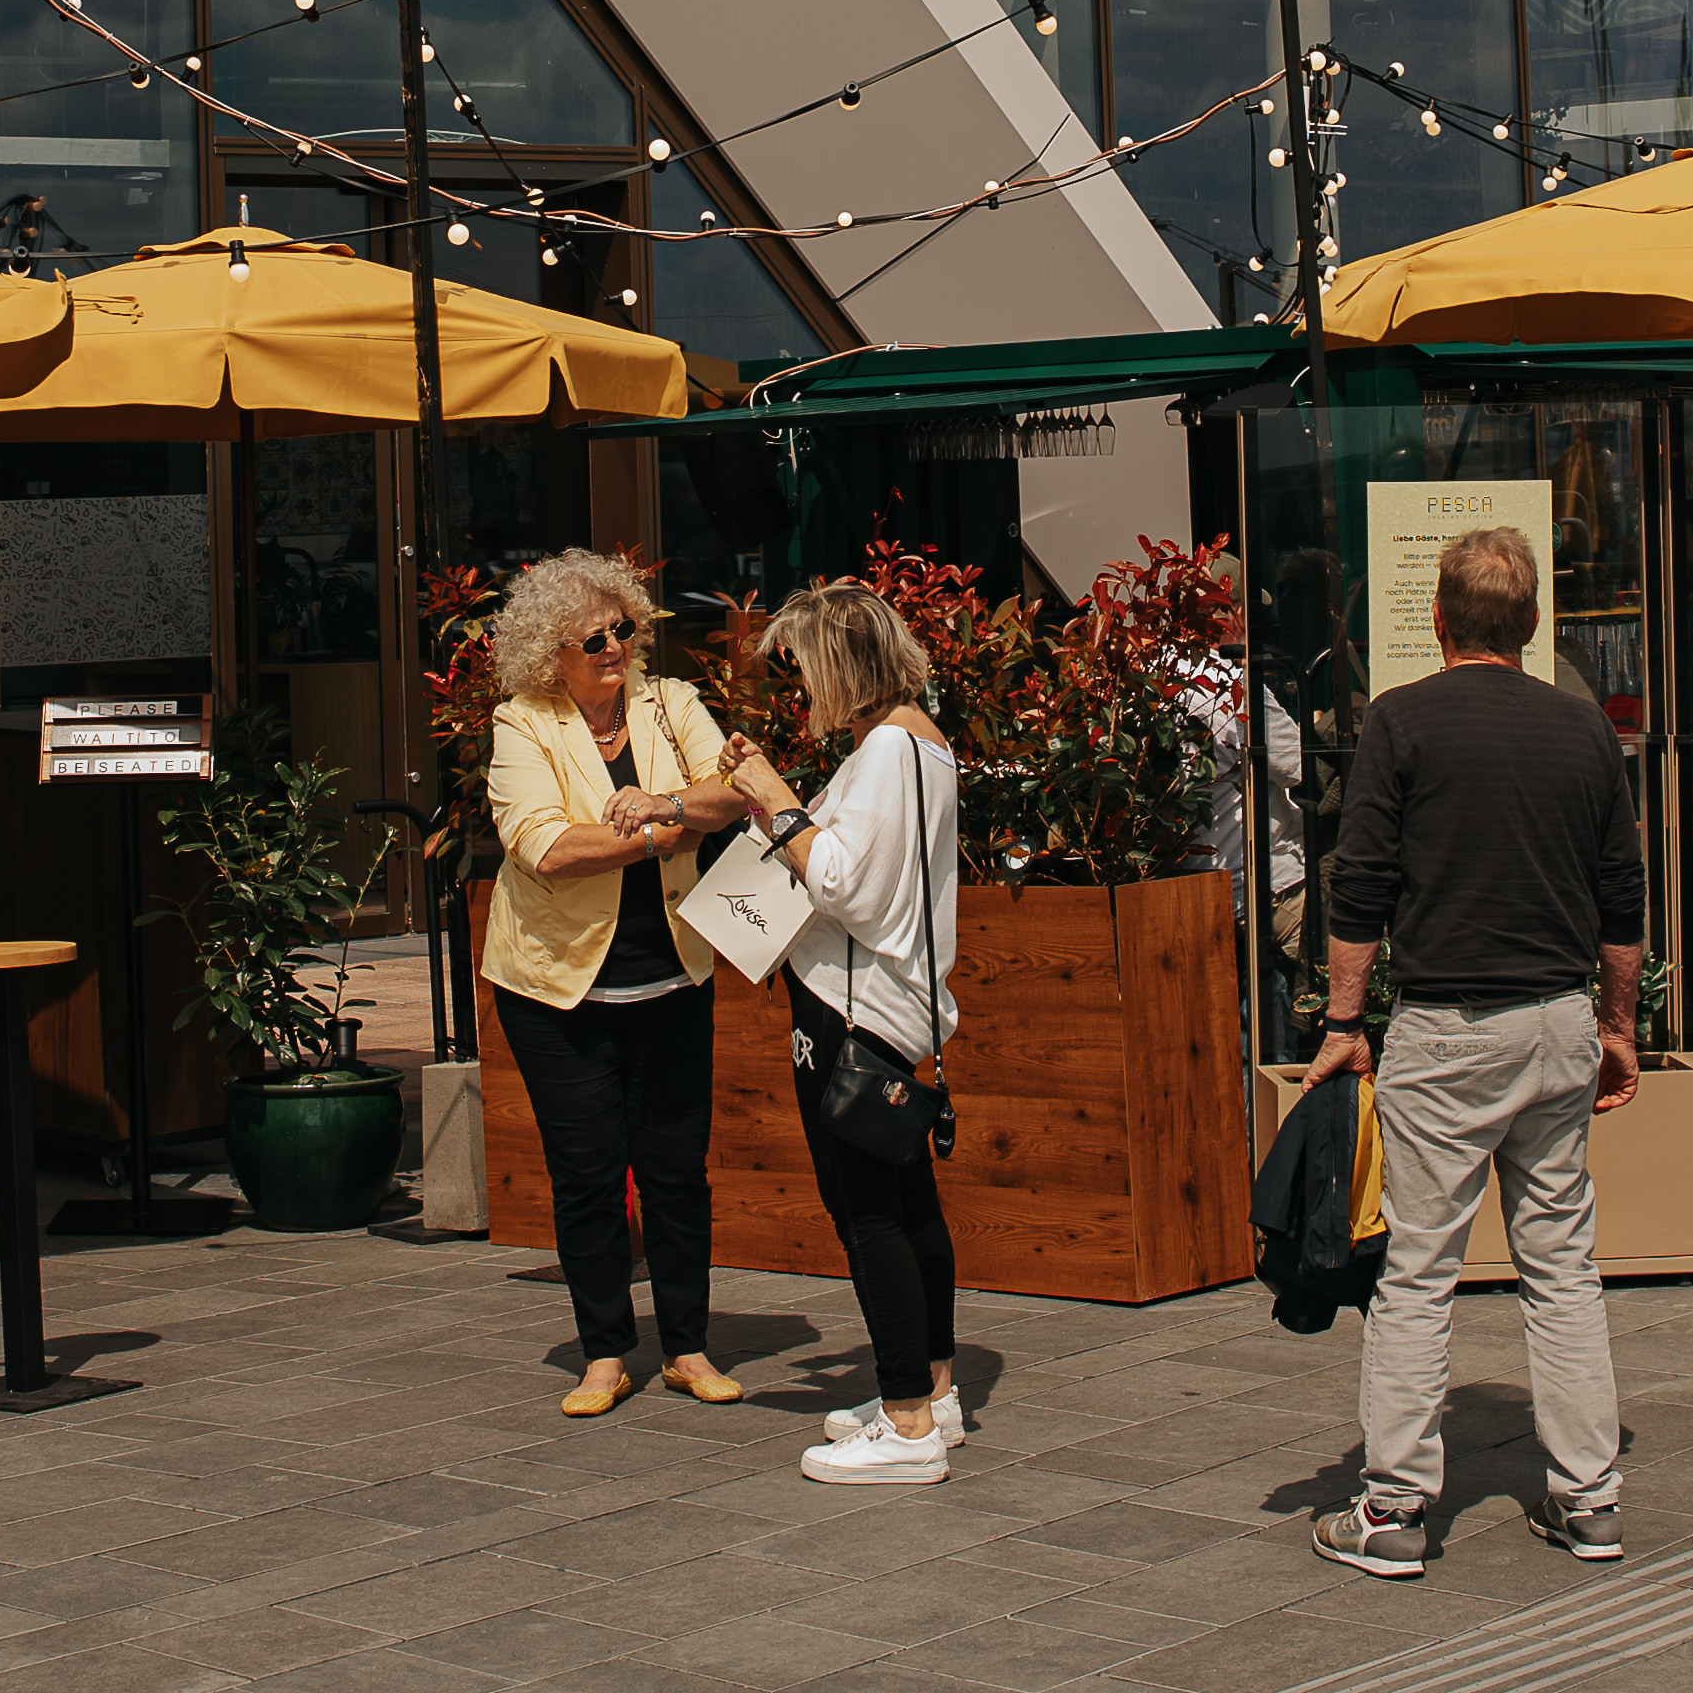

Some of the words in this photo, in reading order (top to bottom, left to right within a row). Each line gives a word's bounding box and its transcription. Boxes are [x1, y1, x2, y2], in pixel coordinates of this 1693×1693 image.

[1428, 496, 1493, 513] PESCA
[80, 703, 174, 717] PLEASE
[149, 731, 177, 744] TO
[58, 762, 84, 774] BE
[716, 892, 769, 935] Lovisa
